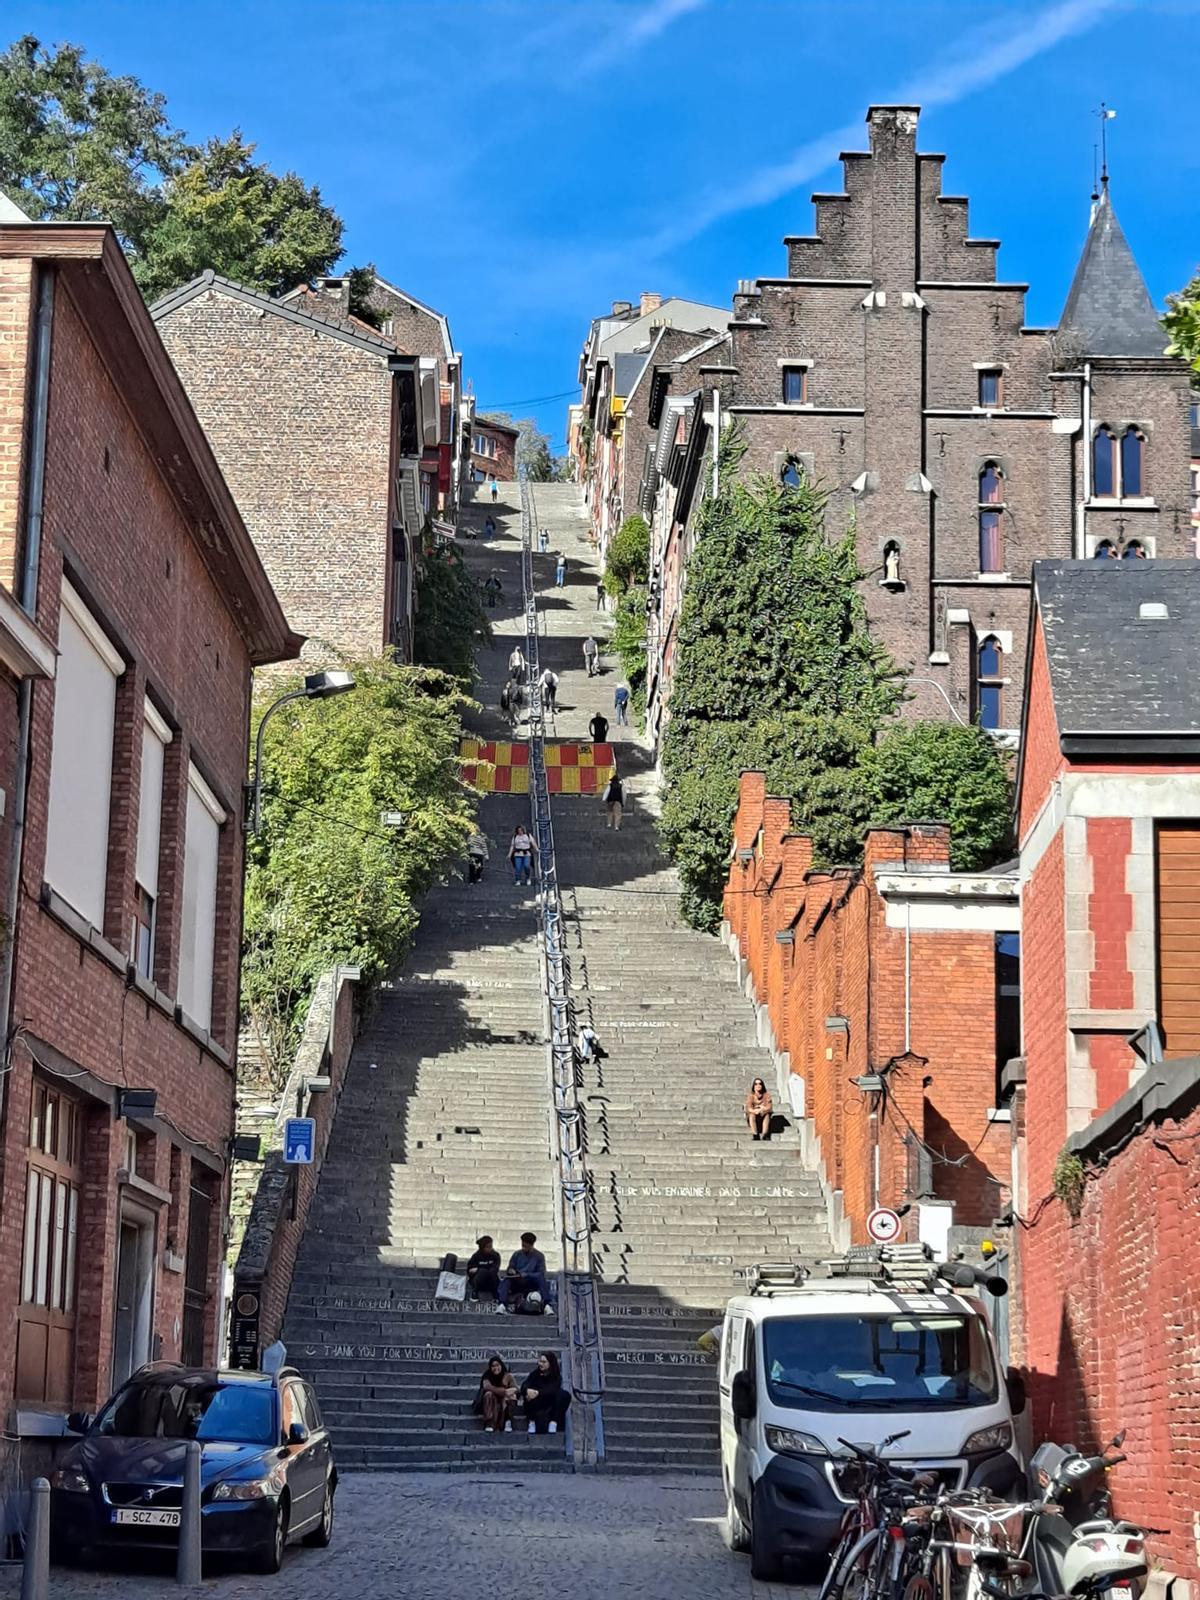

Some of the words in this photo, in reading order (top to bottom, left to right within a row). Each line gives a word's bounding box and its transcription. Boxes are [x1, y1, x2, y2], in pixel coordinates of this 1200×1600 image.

[599, 1186, 625, 1194] MCI
[750, 1187, 760, 1197] LE
[324, 1345, 353, 1357] THANK
[359, 1346, 376, 1358] YOU
[383, 1348, 400, 1358] FOR
[404, 1348, 443, 1360] VISITING
[449, 1350, 487, 1360] WITHOUT
[616, 1353, 645, 1363] MERCI
[654, 1354, 664, 1364] DE
[669, 1354, 706, 1364] VISITER
